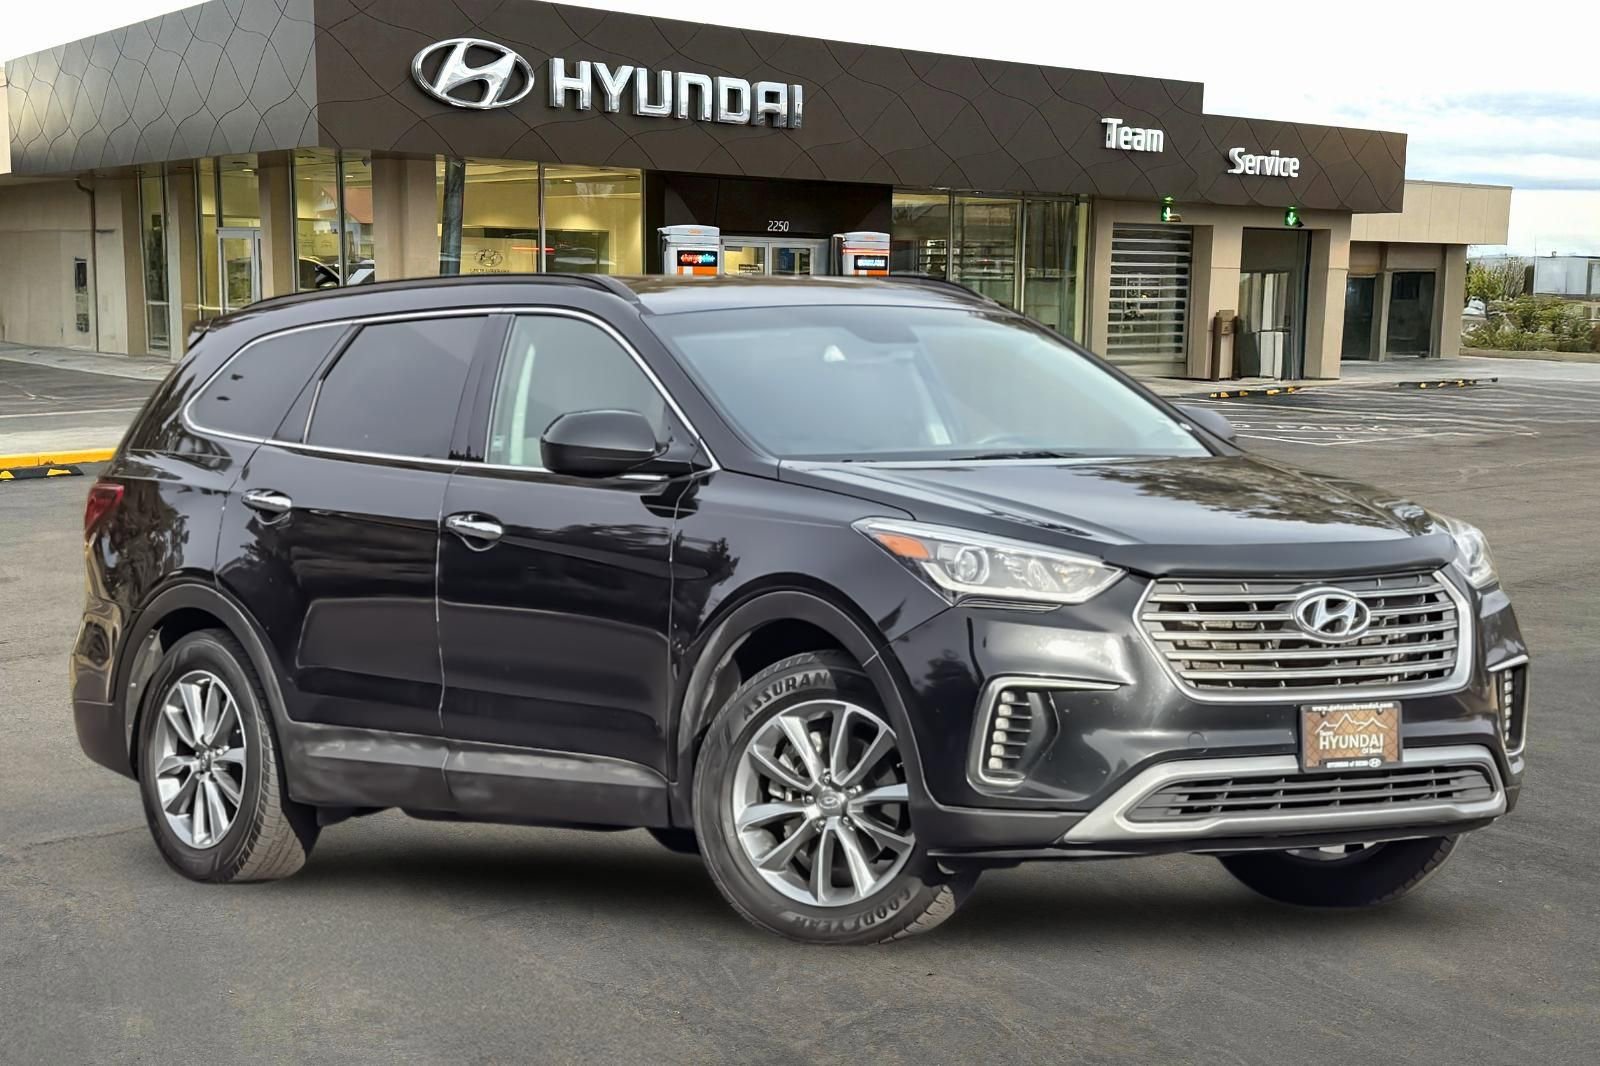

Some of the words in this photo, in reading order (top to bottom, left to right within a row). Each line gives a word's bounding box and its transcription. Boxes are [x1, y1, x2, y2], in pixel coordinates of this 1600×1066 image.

[549, 57, 803, 129] HYUNDAI
[1101, 117, 1164, 153] Team
[1227, 147, 1300, 178] Service
[767, 220, 790, 232] 2250
[1319, 733, 1384, 751] HYUNDAI
